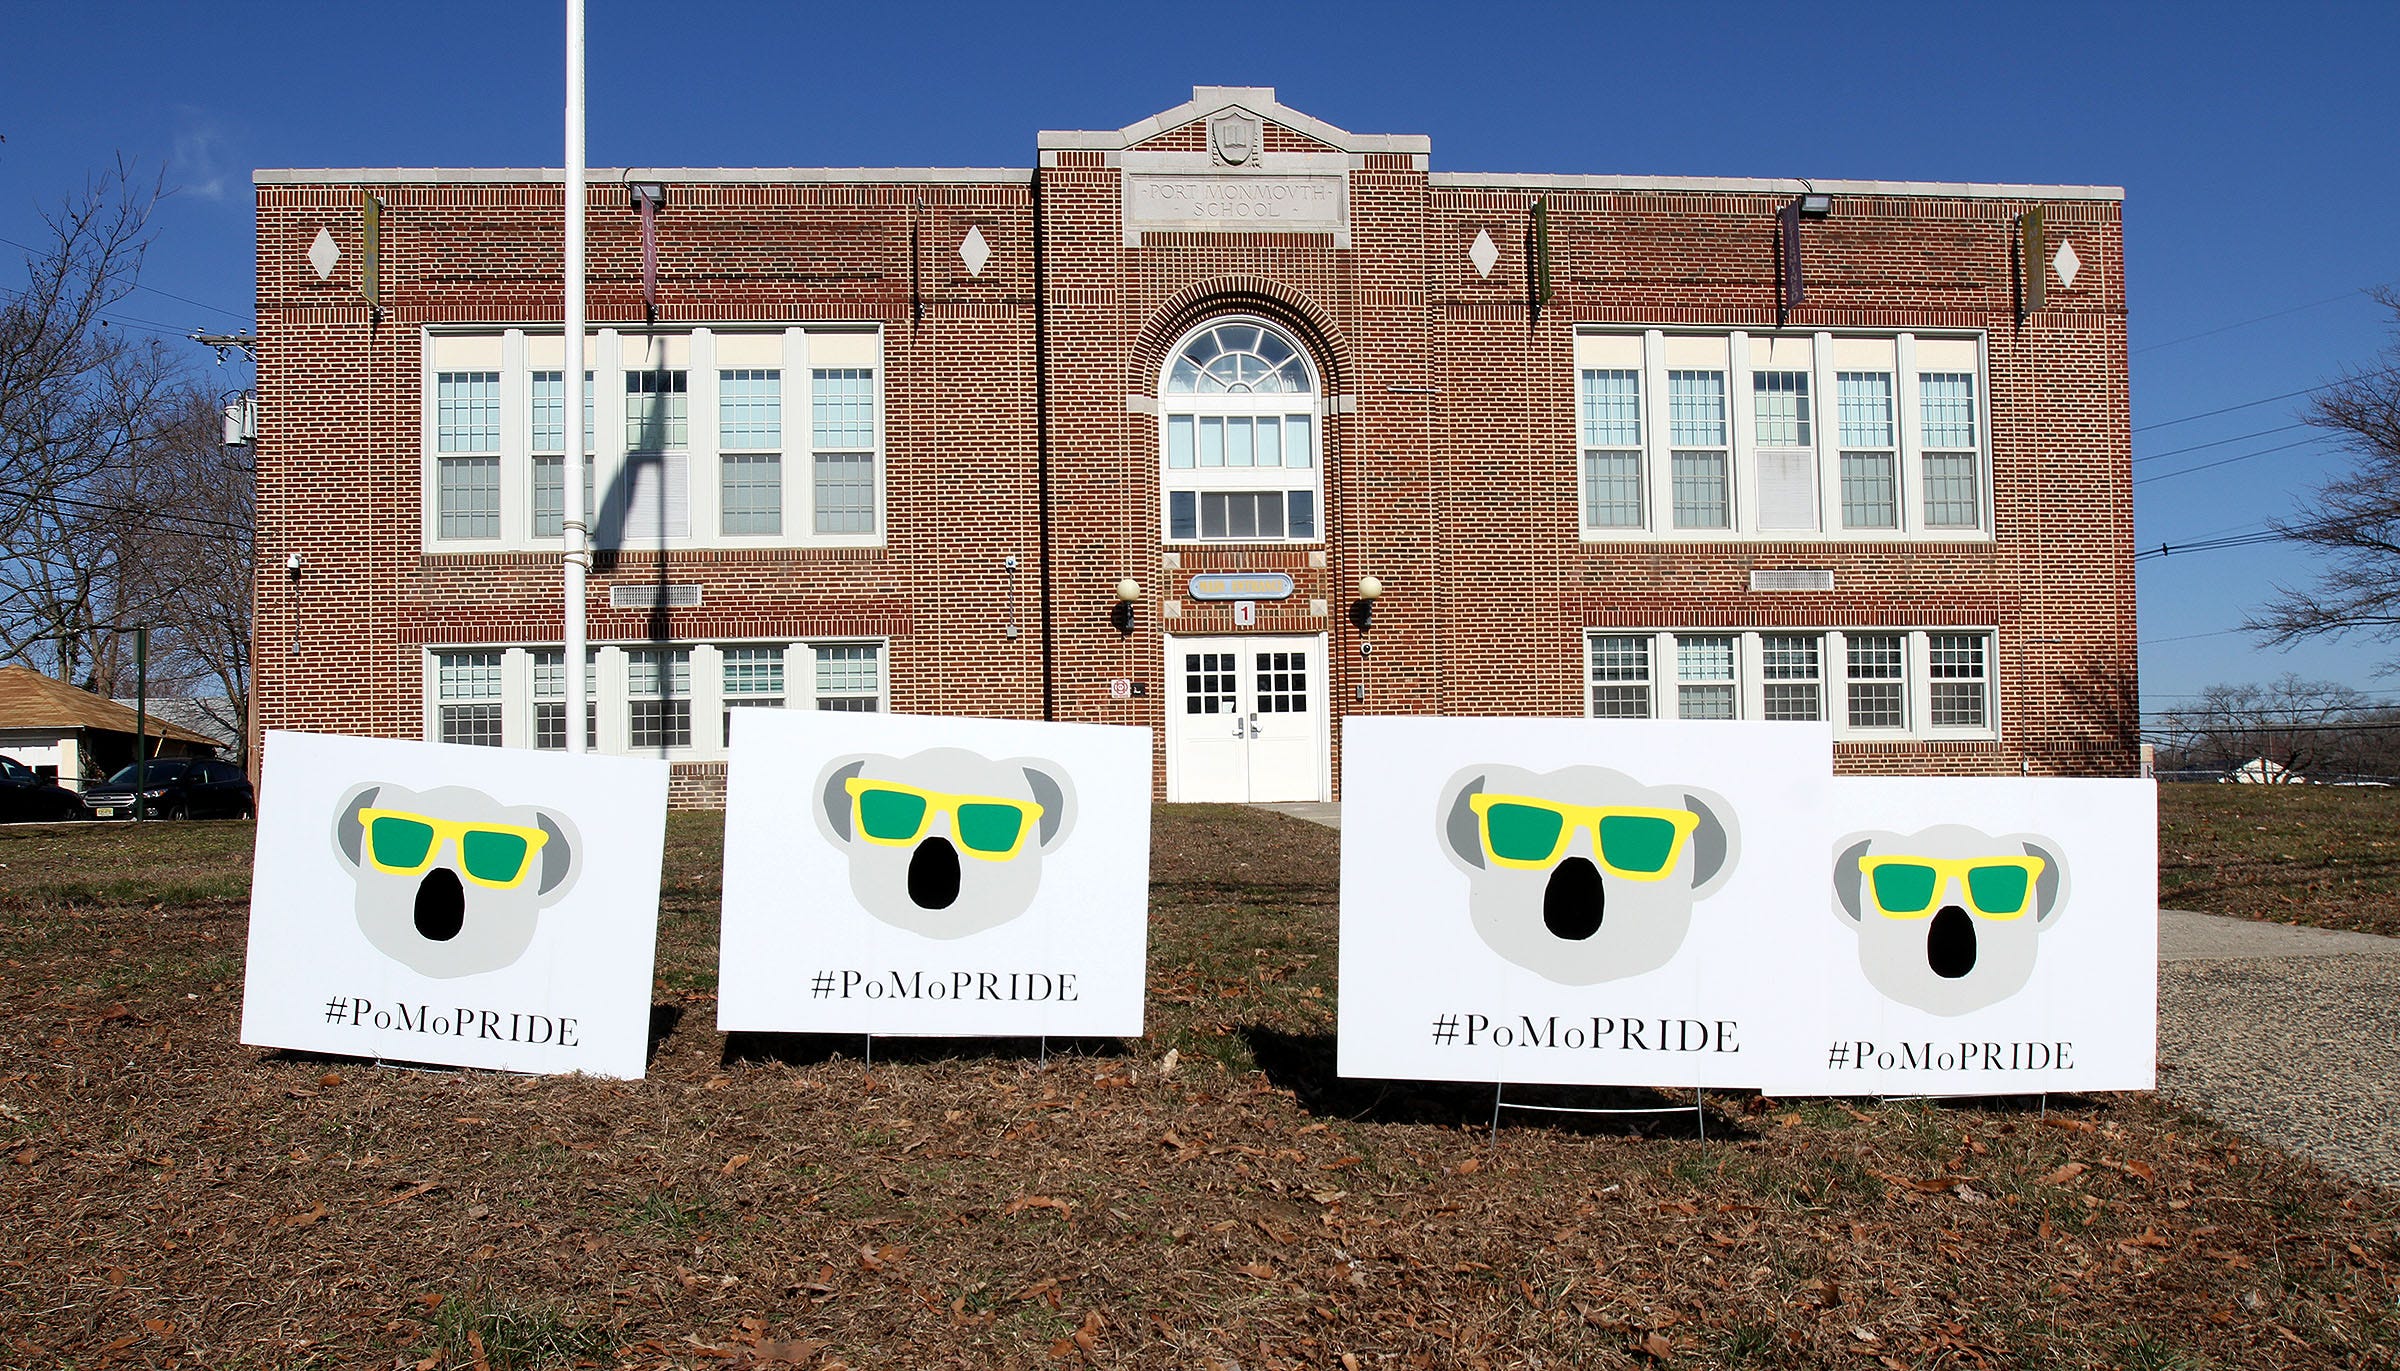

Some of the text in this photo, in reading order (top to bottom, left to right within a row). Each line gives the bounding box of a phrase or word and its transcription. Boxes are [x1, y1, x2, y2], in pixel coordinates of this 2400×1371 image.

[1150, 184, 1196, 200] PORT
[1193, 202, 1280, 217] SCHOOL
[1241, 606, 1249, 621] 1
[811, 970, 1079, 1002] #PoMoPRIDE
[325, 996, 580, 1048] #PoMoPRIDE
[1432, 1013, 1740, 1053] #PoMoPRIDE
[1828, 1041, 2074, 1071] #PoMoPRIDE
